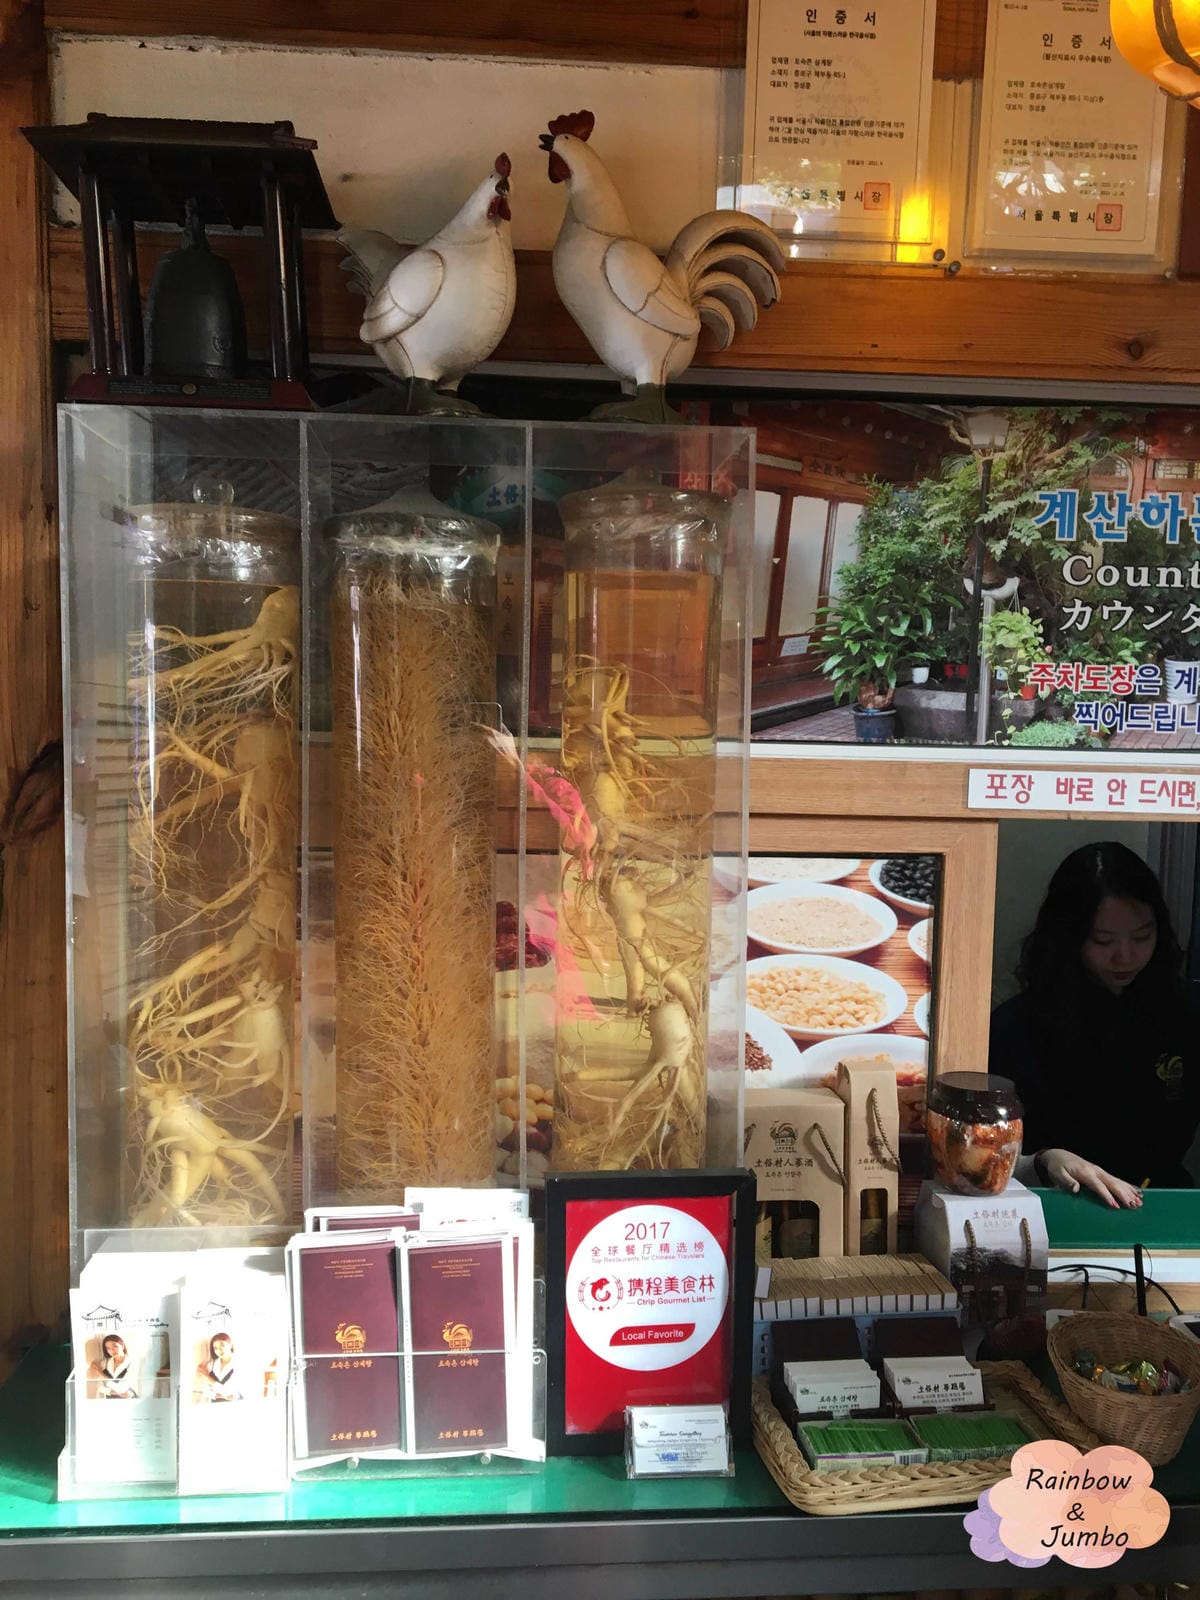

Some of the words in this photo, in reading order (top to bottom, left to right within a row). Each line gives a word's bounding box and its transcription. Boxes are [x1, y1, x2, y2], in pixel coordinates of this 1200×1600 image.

[1033, 488, 1200, 543] 계산하
[1029, 662, 1163, 696] 주차도장은
[985, 773, 1034, 805] 포장
[1056, 776, 1094, 804] 바로
[1107, 778, 1127, 806] 안
[624, 1221, 671, 1241] 2017
[591, 1241, 704, 1257] 全球餐厅精选榜
[592, 1257, 602, 1265] Top
[604, 1255, 640, 1264] Restaurants
[651, 1253, 676, 1261] Chinese
[678, 1252, 705, 1260] Travelers
[627, 1274, 715, 1297] 携程美食林
[637, 1297, 656, 1307] Ctrip
[657, 1296, 690, 1305] Gourmet
[622, 1330, 646, 1341] Local
[647, 1328, 684, 1340] Favorite
